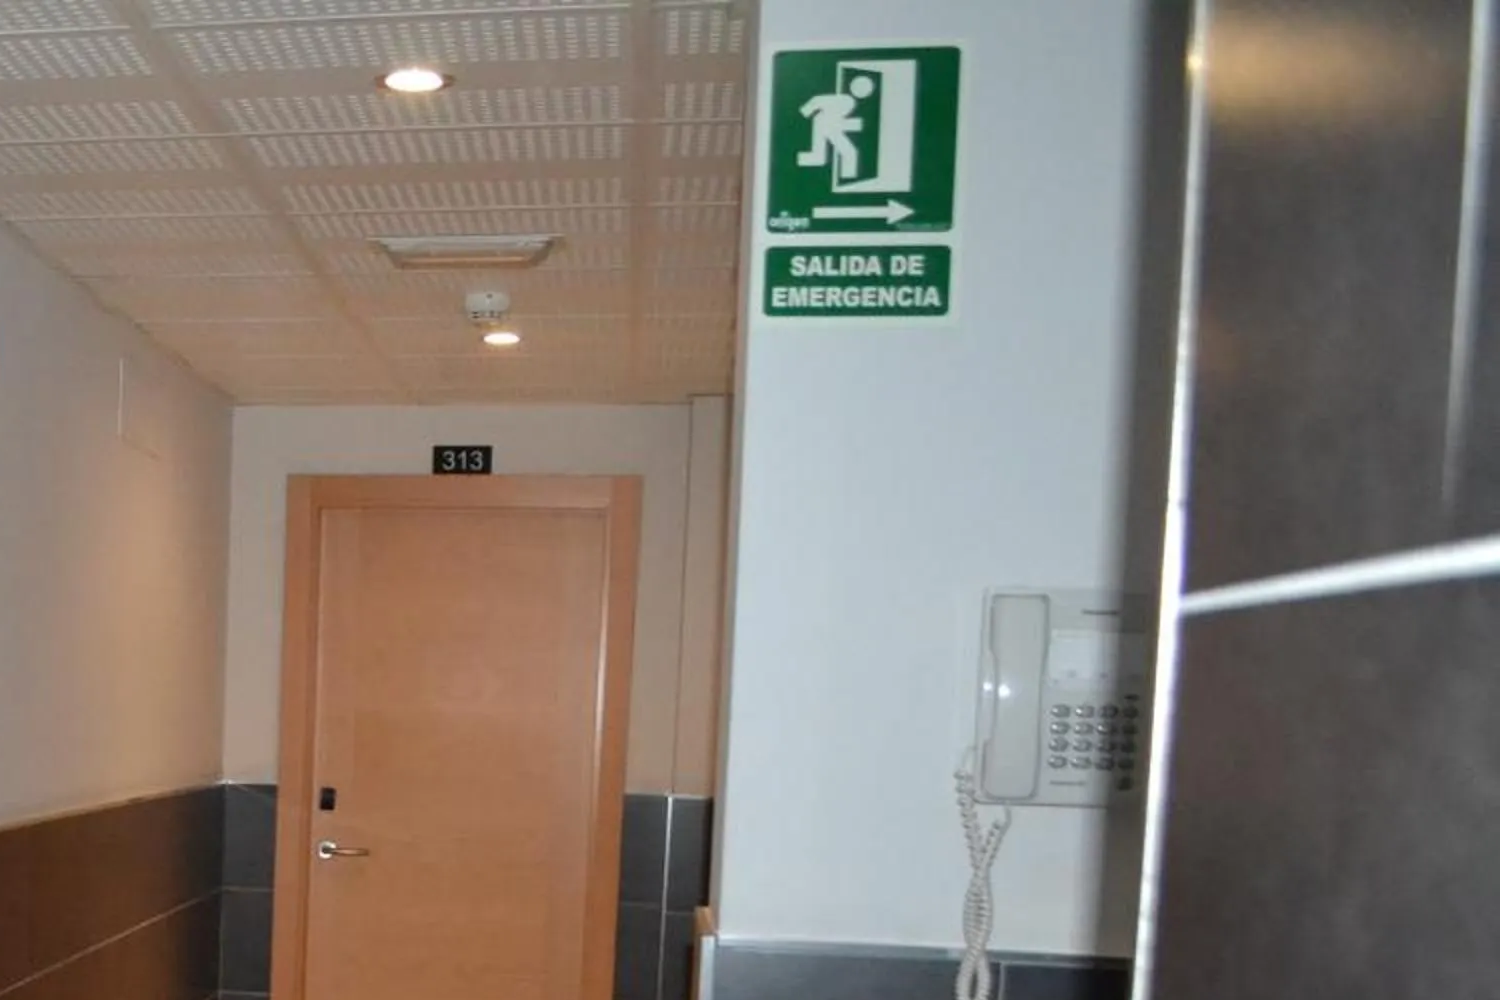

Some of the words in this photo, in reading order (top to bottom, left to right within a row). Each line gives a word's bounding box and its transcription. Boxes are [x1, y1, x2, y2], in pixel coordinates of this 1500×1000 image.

[790, 256, 882, 276] SALIDA
[890, 255, 925, 275] DE
[771, 285, 941, 308] EMERGENCIA
[442, 450, 483, 470] 313
